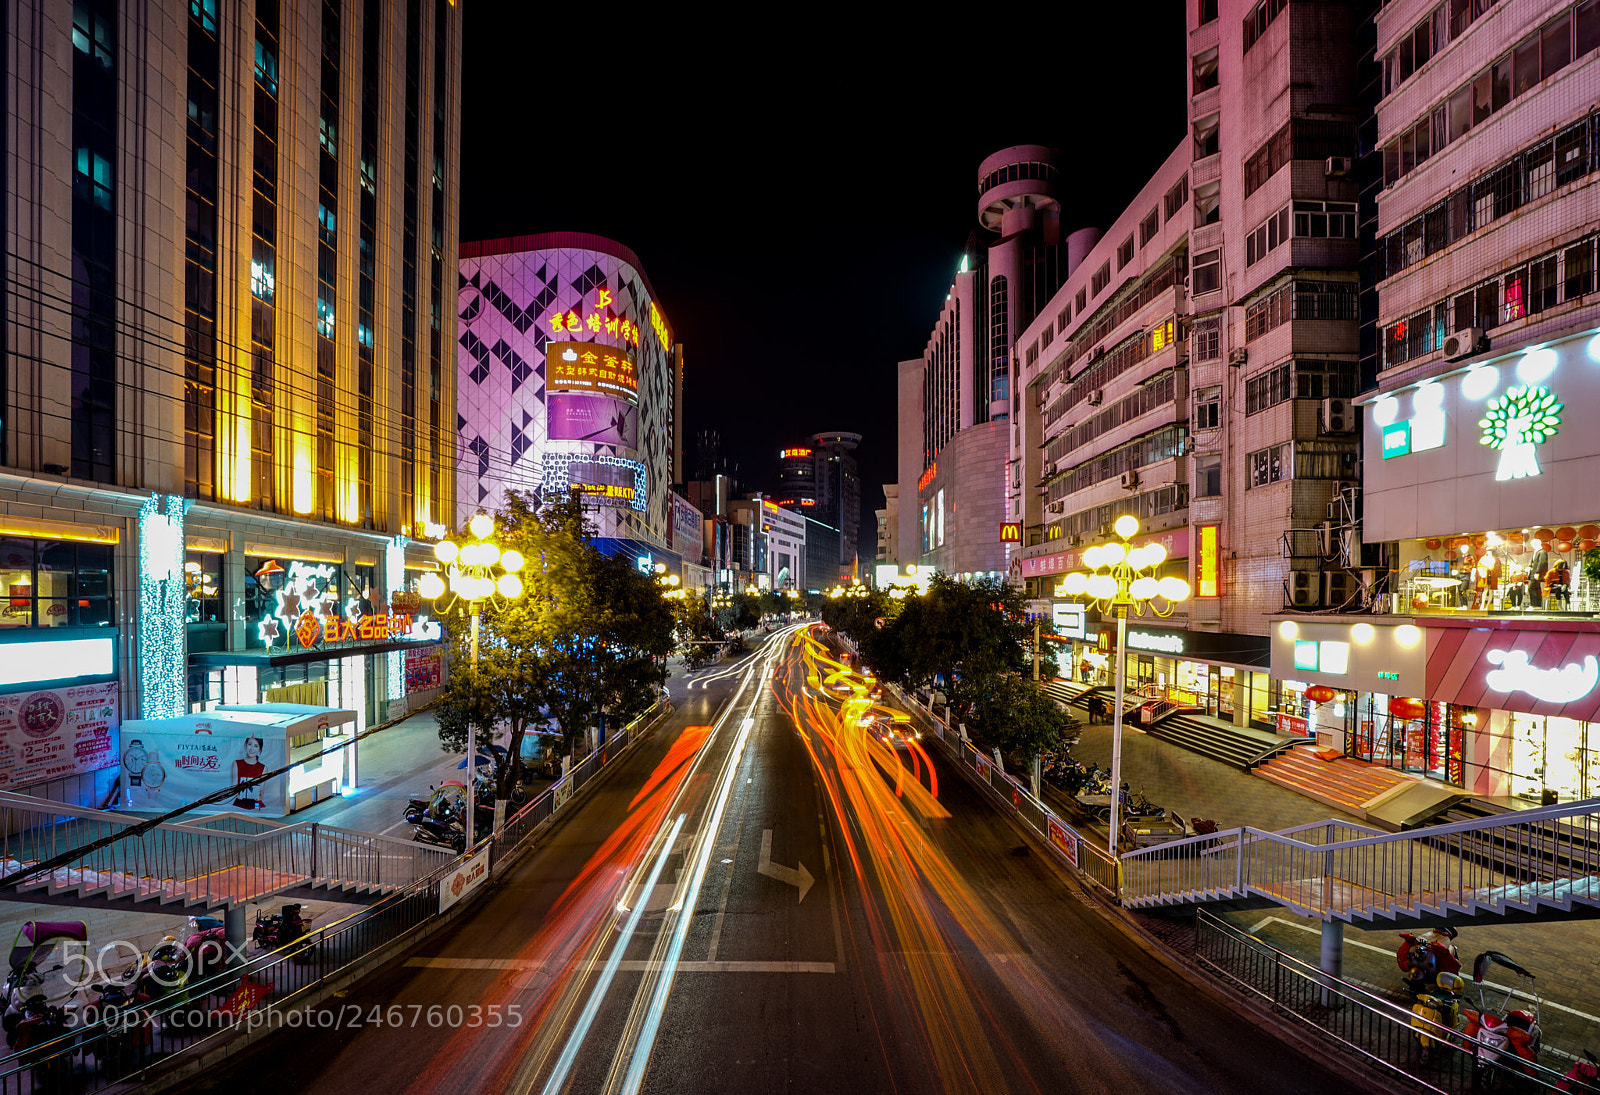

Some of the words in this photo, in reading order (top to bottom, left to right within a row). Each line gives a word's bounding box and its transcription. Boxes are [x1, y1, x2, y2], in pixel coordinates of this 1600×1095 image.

[324, 613, 413, 643] 百大名品中心
